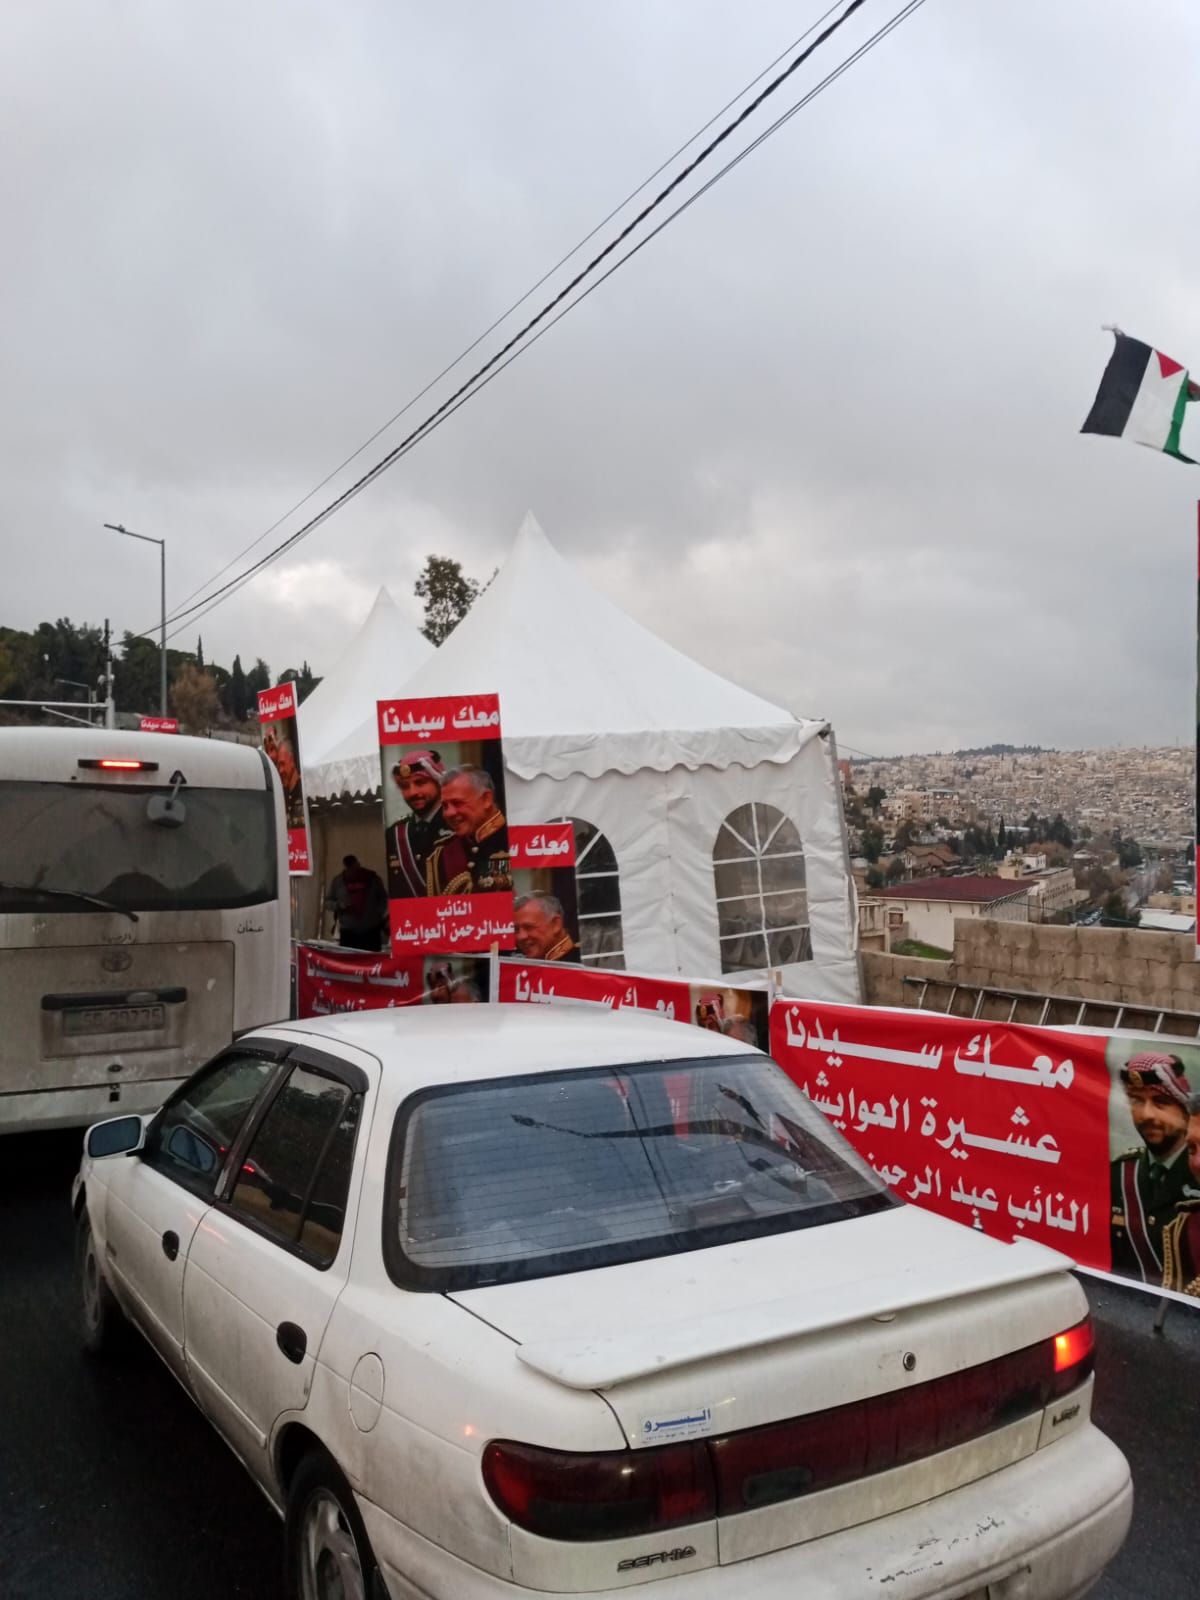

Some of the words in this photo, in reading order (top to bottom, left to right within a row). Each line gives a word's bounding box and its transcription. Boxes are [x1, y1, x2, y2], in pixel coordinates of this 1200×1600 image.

[383, 707, 445, 738] سيدنا
[453, 706, 499, 728] معك
[525, 834, 570, 857] معك
[436, 901, 472, 920] النائب
[786, 1006, 942, 1069] سيدنا
[953, 1034, 1075, 1089] معك
[920, 1096, 1062, 1164] عشيرة
[950, 1175, 999, 1216] عبد
[1007, 1185, 1089, 1236] النائب
[617, 1546, 697, 1573] SEPHIA
